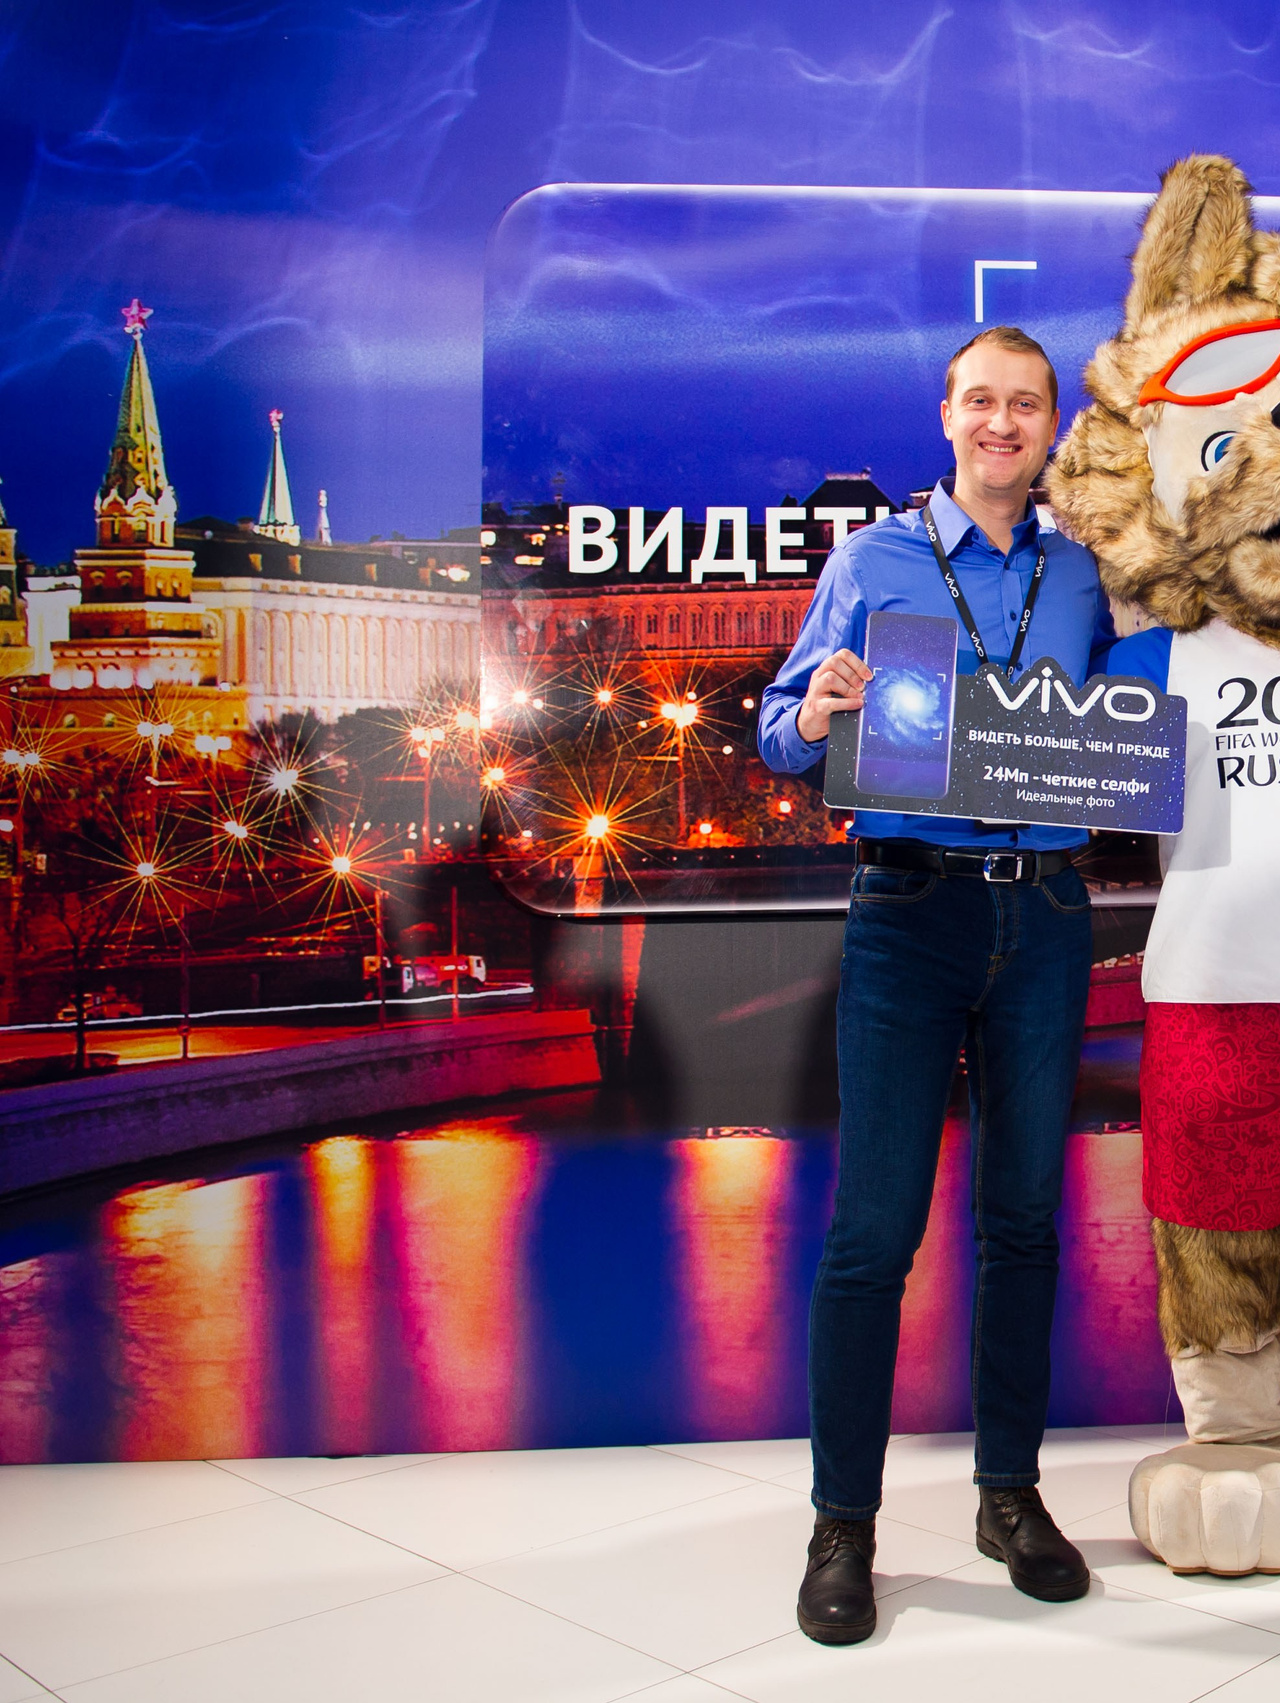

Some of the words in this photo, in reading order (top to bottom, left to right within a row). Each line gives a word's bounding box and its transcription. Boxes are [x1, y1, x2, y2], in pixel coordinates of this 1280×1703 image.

[926, 521, 936, 542] vivo
[568, 506, 889, 583] ВИДЕТ
[1035, 555, 1045, 578] vivo
[944, 573, 959, 598] vivo
[1020, 609, 1030, 632] vivo
[971, 631, 984, 657] vivo
[986, 666, 1156, 722] vivo
[968, 729, 1022, 745] ВИДЕТЬ
[1024, 734, 1083, 752] БОЛЬШЕ,
[1085, 740, 1113, 754] ЧЕМ
[1117, 743, 1171, 759] ПРЕЖДЕ
[1215, 733, 1256, 750] FIFA
[983, 765, 1029, 783] 24Мп
[1100, 778, 1150, 796] селфи
[1016, 788, 1083, 805] Идеальные
[1086, 795, 1116, 808] фото
